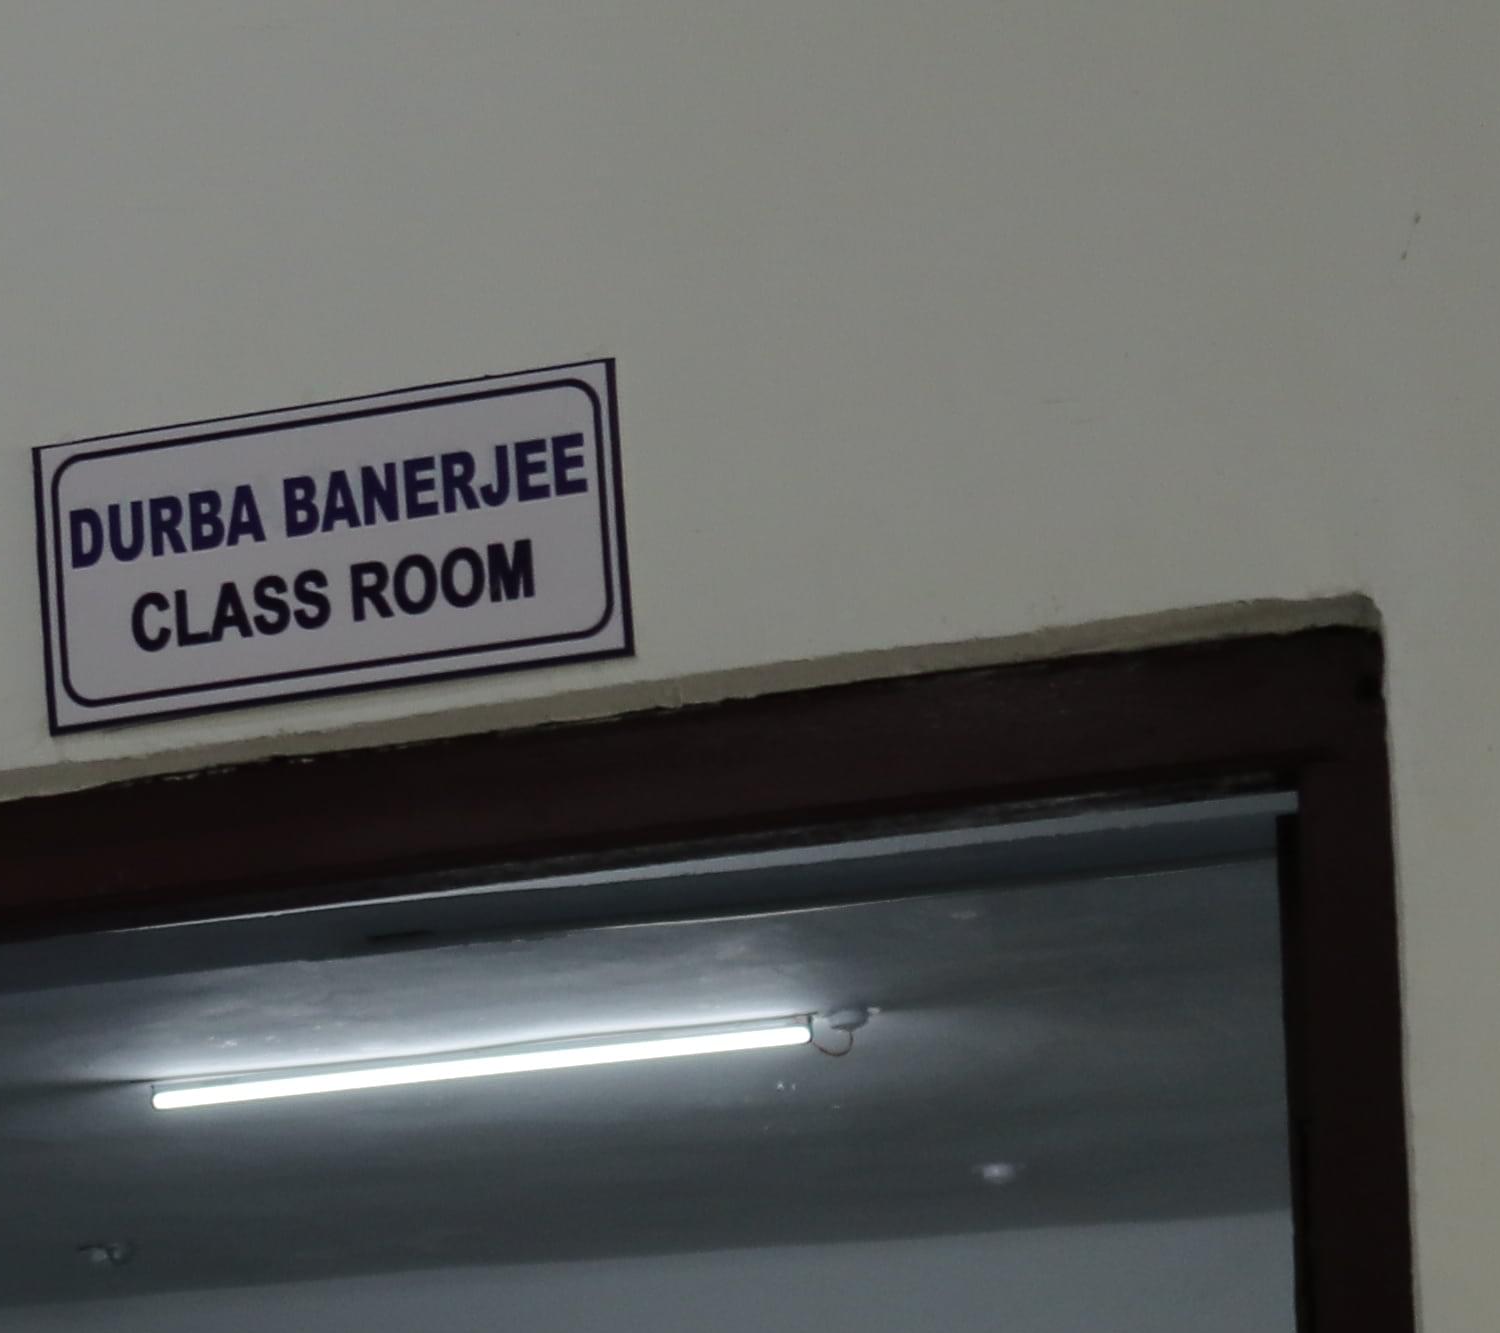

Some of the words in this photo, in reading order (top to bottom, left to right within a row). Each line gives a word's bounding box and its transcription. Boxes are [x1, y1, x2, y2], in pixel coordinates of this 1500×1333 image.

[69, 484, 266, 569] DURBA
[283, 433, 588, 538] BANERJEE
[132, 569, 331, 652] CLASS
[350, 539, 535, 621] ROOM
